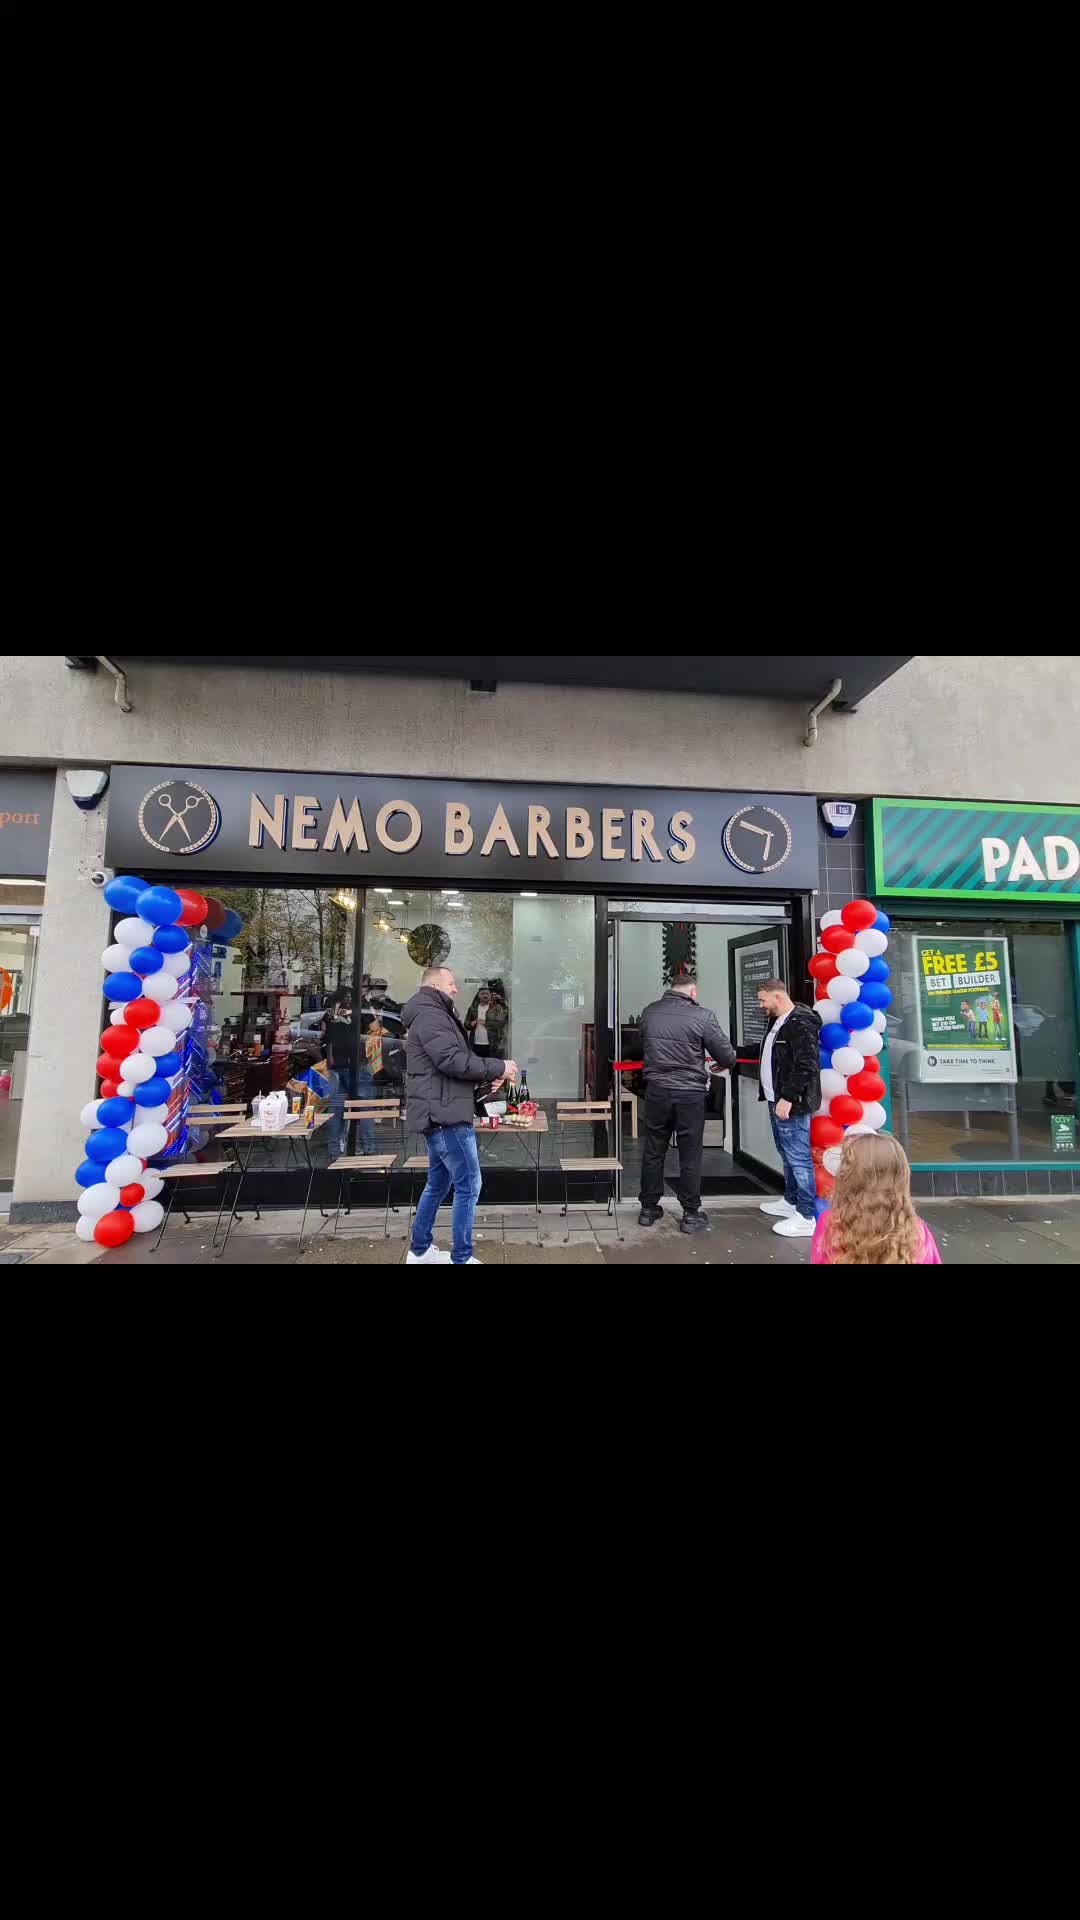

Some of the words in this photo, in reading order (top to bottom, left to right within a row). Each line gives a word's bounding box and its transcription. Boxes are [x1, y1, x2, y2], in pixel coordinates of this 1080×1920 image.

[248, 792, 422, 854] NEMO
[444, 801, 697, 863] BARBERS
[981, 835, 1080, 882] PAD
[922, 953, 968, 976] FREE
[974, 951, 998, 971] £5
[930, 978, 945, 987] BET
[958, 974, 996, 985] BUILDER
